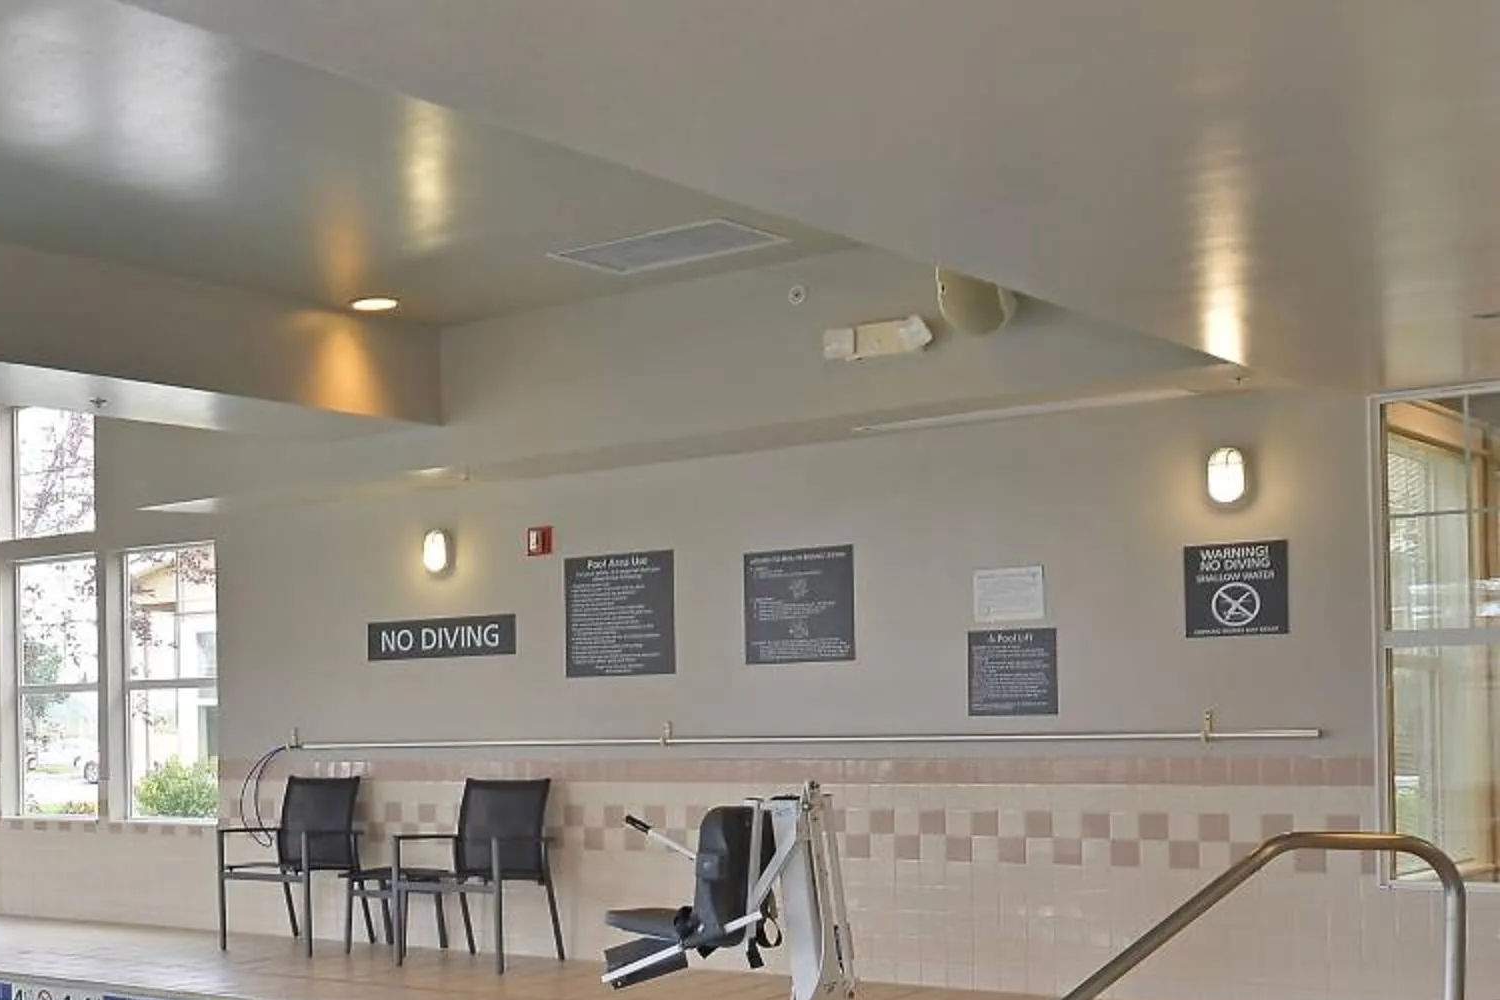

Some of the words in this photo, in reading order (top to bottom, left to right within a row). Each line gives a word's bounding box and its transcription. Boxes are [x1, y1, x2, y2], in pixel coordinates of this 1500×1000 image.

[1201, 545, 1269, 560] WARNING!
[1201, 559, 1221, 572] NO
[1224, 557, 1270, 570] DIVING
[380, 629, 414, 653] NO
[420, 623, 500, 651] DIVING
